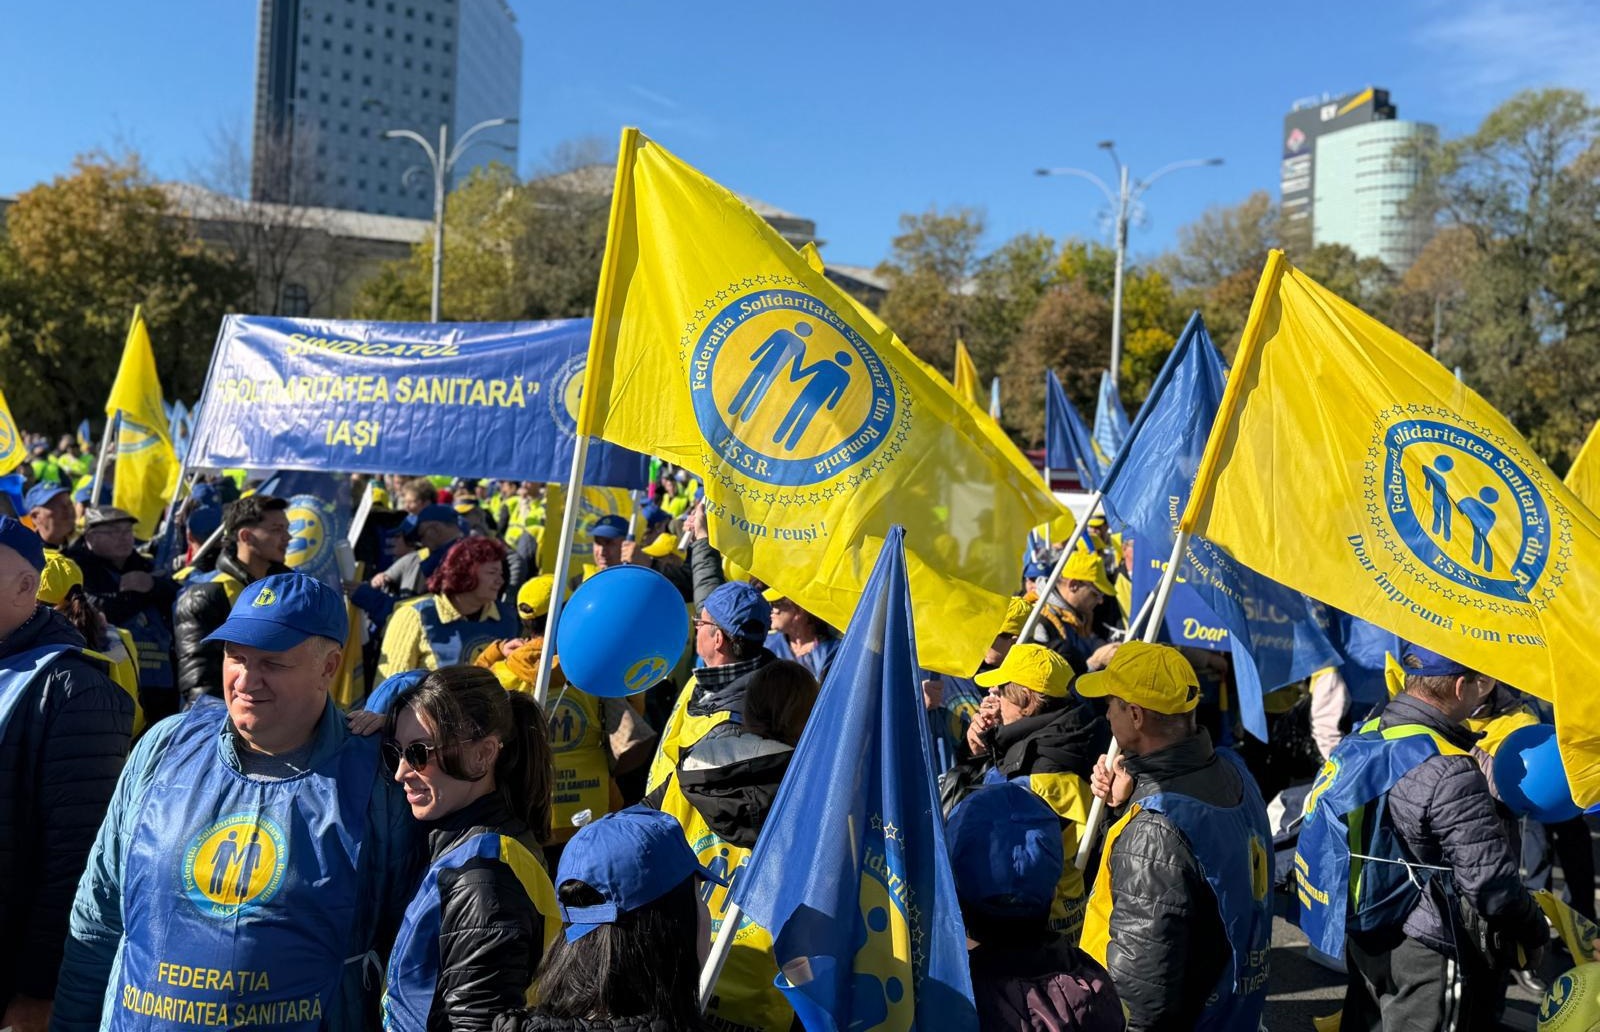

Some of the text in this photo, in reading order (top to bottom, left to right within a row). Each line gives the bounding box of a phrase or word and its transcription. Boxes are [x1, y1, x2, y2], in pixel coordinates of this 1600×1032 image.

[286, 332, 461, 358] SINDICATUL
[692, 316, 736, 392] Federația
[872, 397, 891, 422] din
[325, 419, 379, 455] IAȘI
[813, 423, 881, 475] România
[1168, 495, 1180, 524] Doar
[731, 512, 767, 539] vom
[773, 523, 818, 545] reuși
[1522, 537, 1544, 566] din
[1347, 533, 1377, 573] Doar
[1374, 571, 1454, 631] împreună
[1459, 623, 1501, 643] vom
[1182, 617, 1228, 643] Doar
[122, 984, 323, 1028] SOLIDARITATEA SANITARĂ
